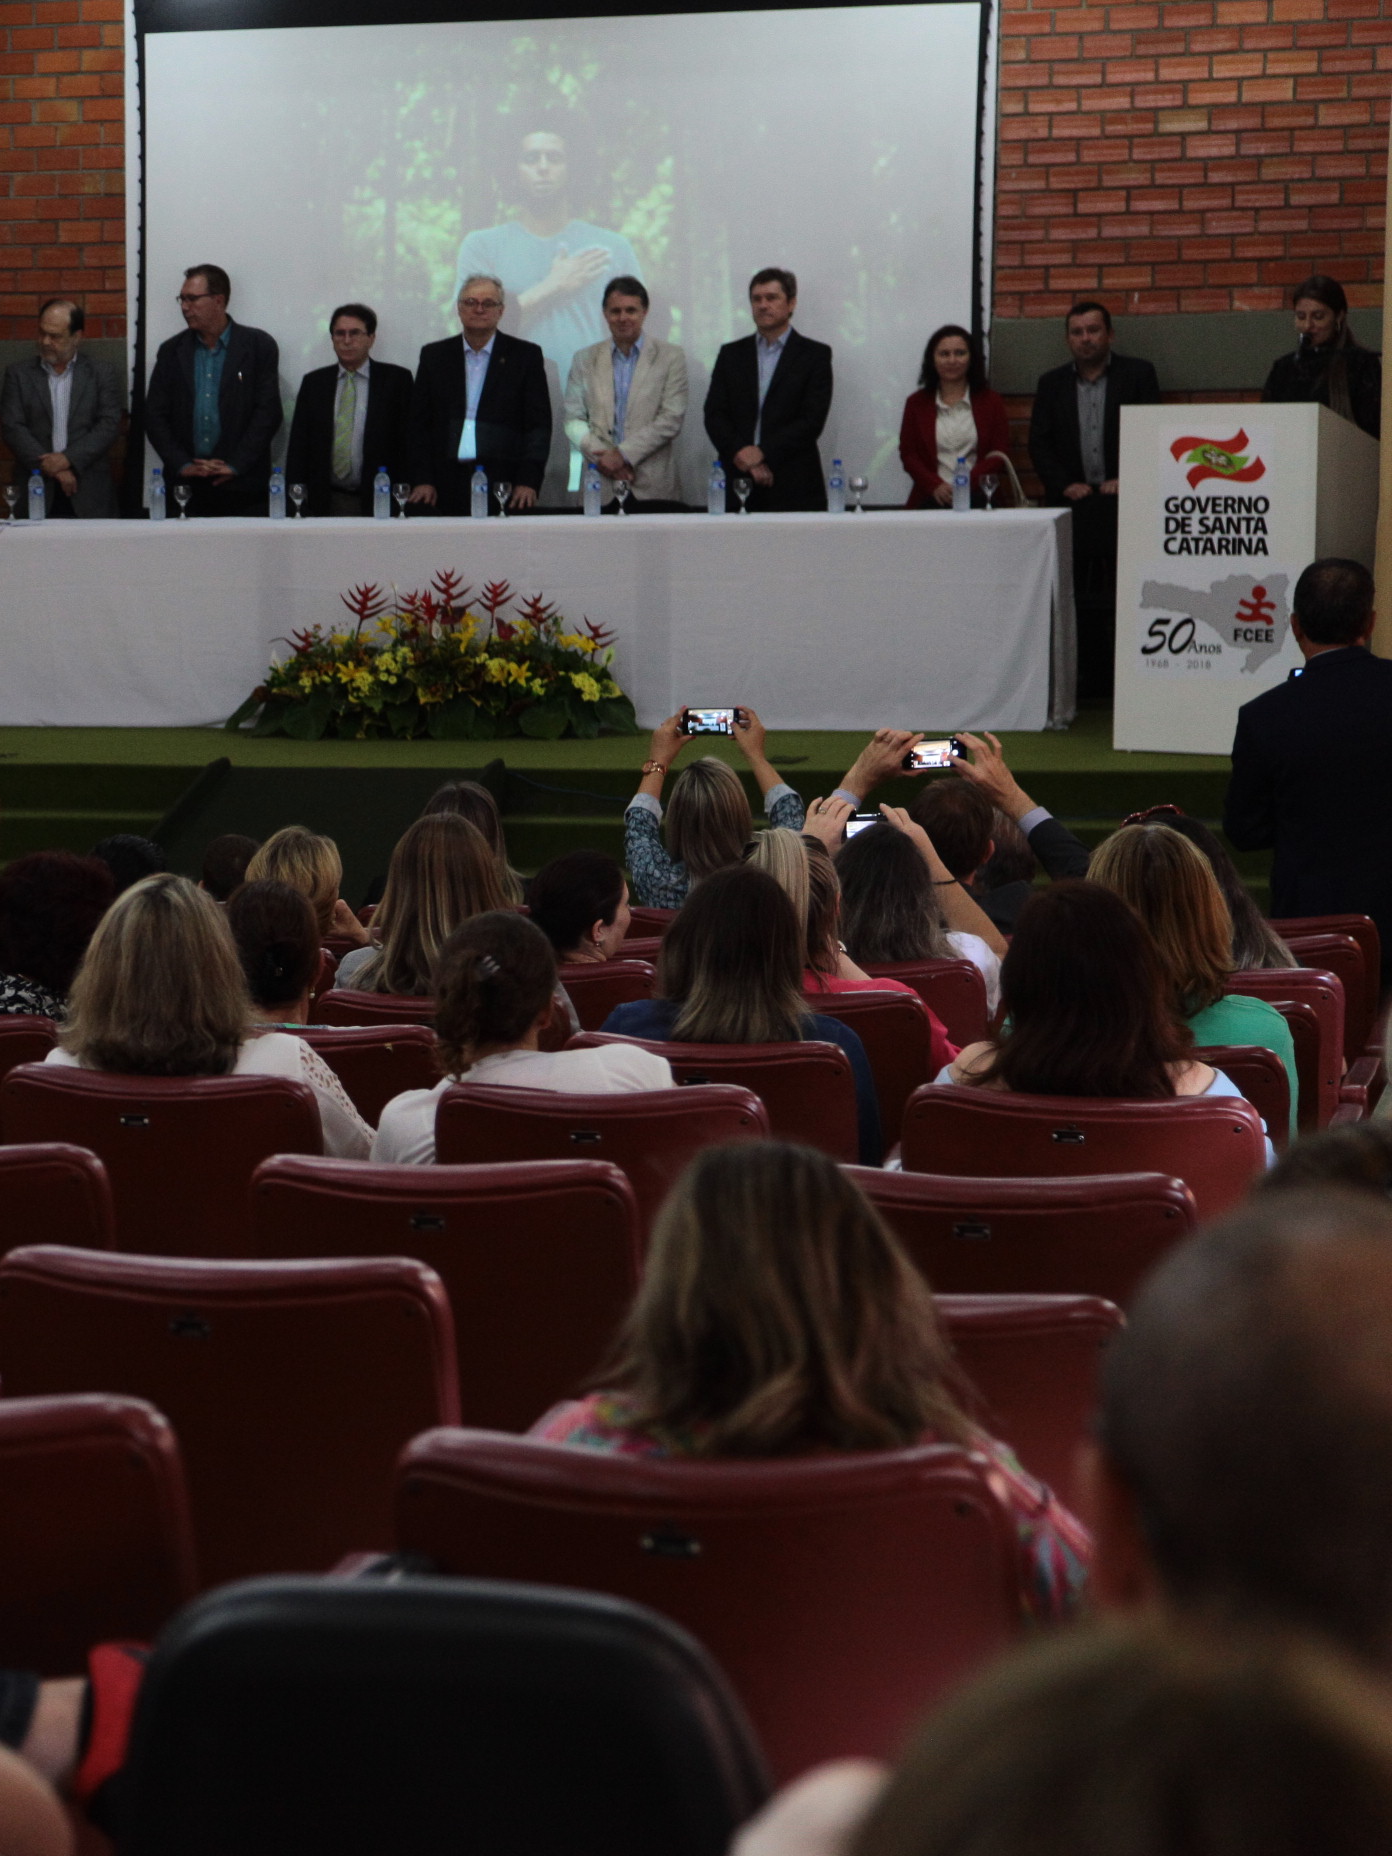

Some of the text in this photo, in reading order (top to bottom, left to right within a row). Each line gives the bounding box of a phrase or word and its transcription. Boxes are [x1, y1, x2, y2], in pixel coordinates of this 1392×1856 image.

[1164, 496, 1270, 514] GOVERNO
[1164, 516, 1268, 535] DE SANTA
[1163, 537, 1269, 556] CATARINA
[1141, 618, 1222, 656] 50 Anos
[1233, 628, 1275, 642] FCEE
[1146, 658, 1169, 668] 1968
[1187, 659, 1211, 670] 2018
